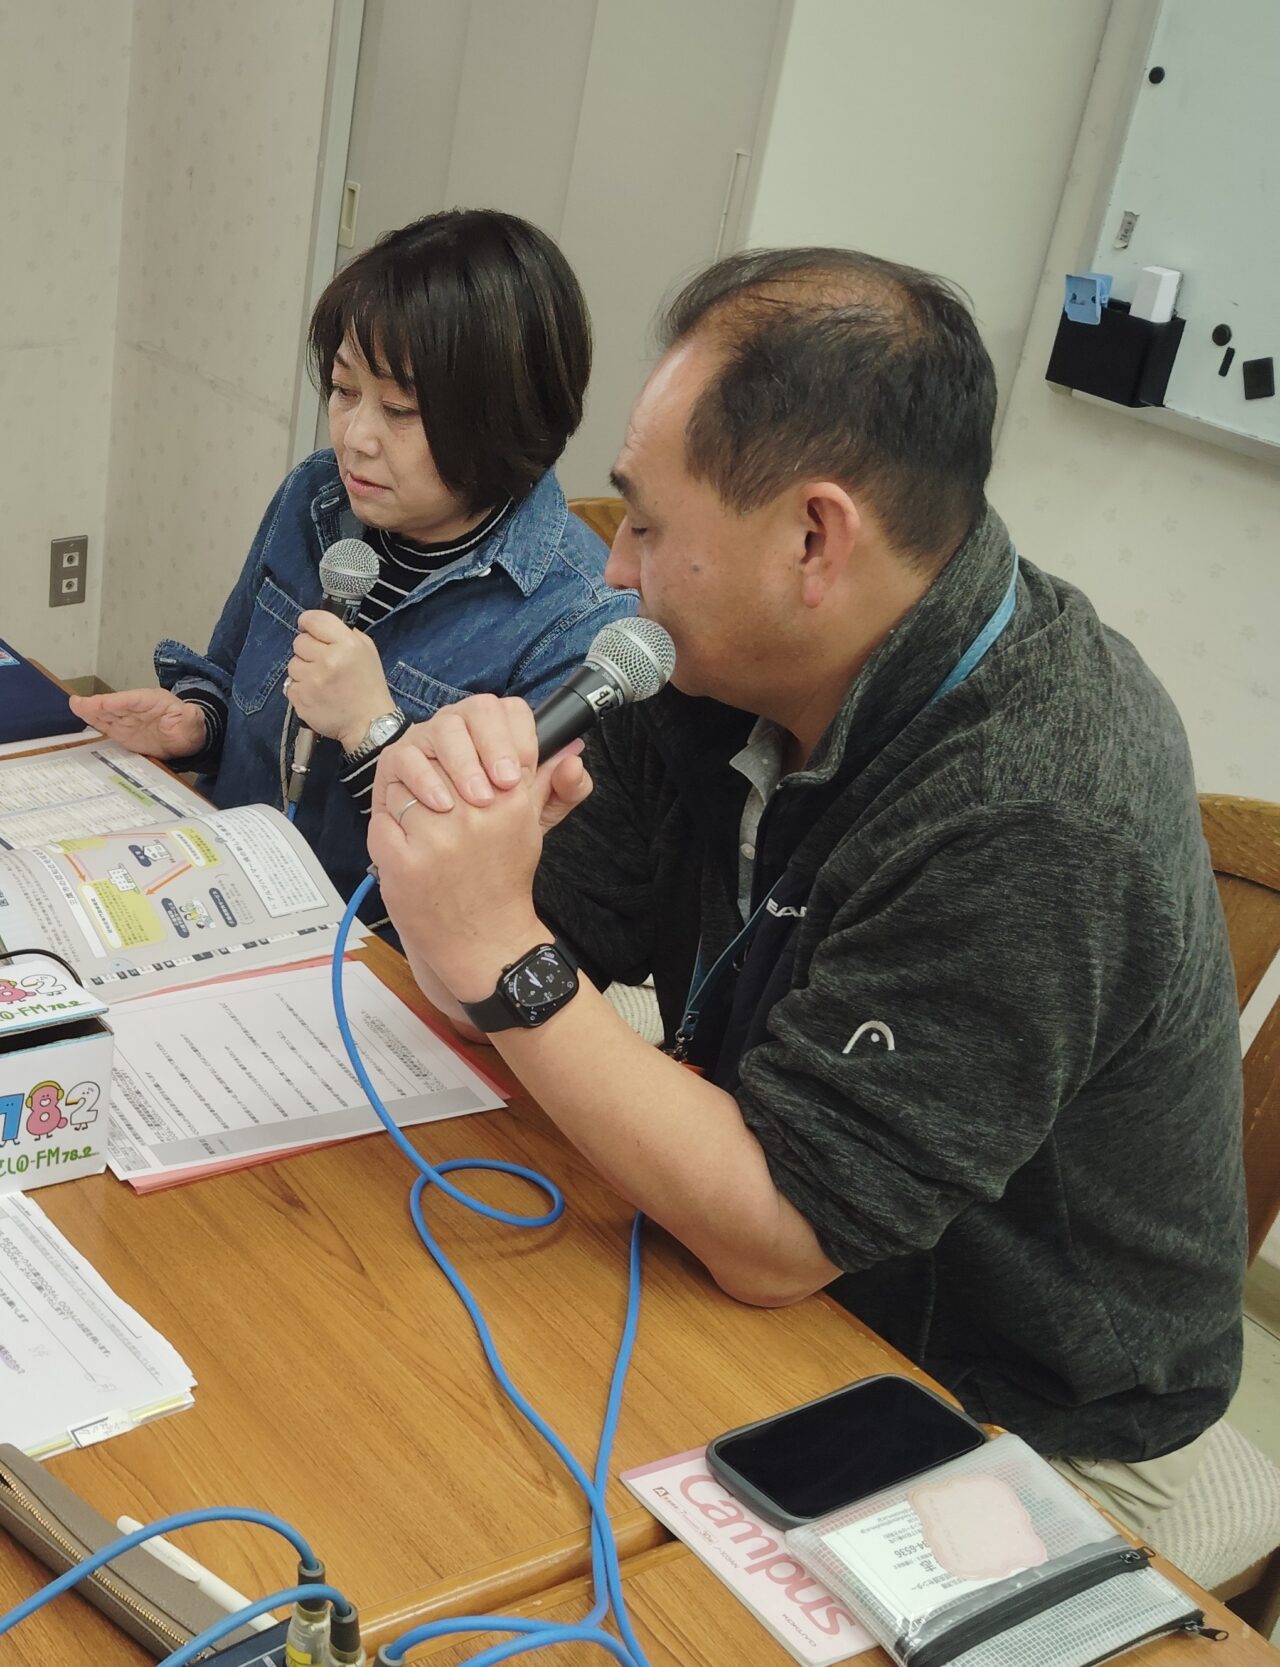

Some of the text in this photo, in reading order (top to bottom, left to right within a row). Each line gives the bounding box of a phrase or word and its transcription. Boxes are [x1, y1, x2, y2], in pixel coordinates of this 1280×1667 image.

[61, 1146, 96, 1164] 78.2
[680, 1474, 856, 1637] Campus
[781, 1613, 817, 1648] KOKUYO
